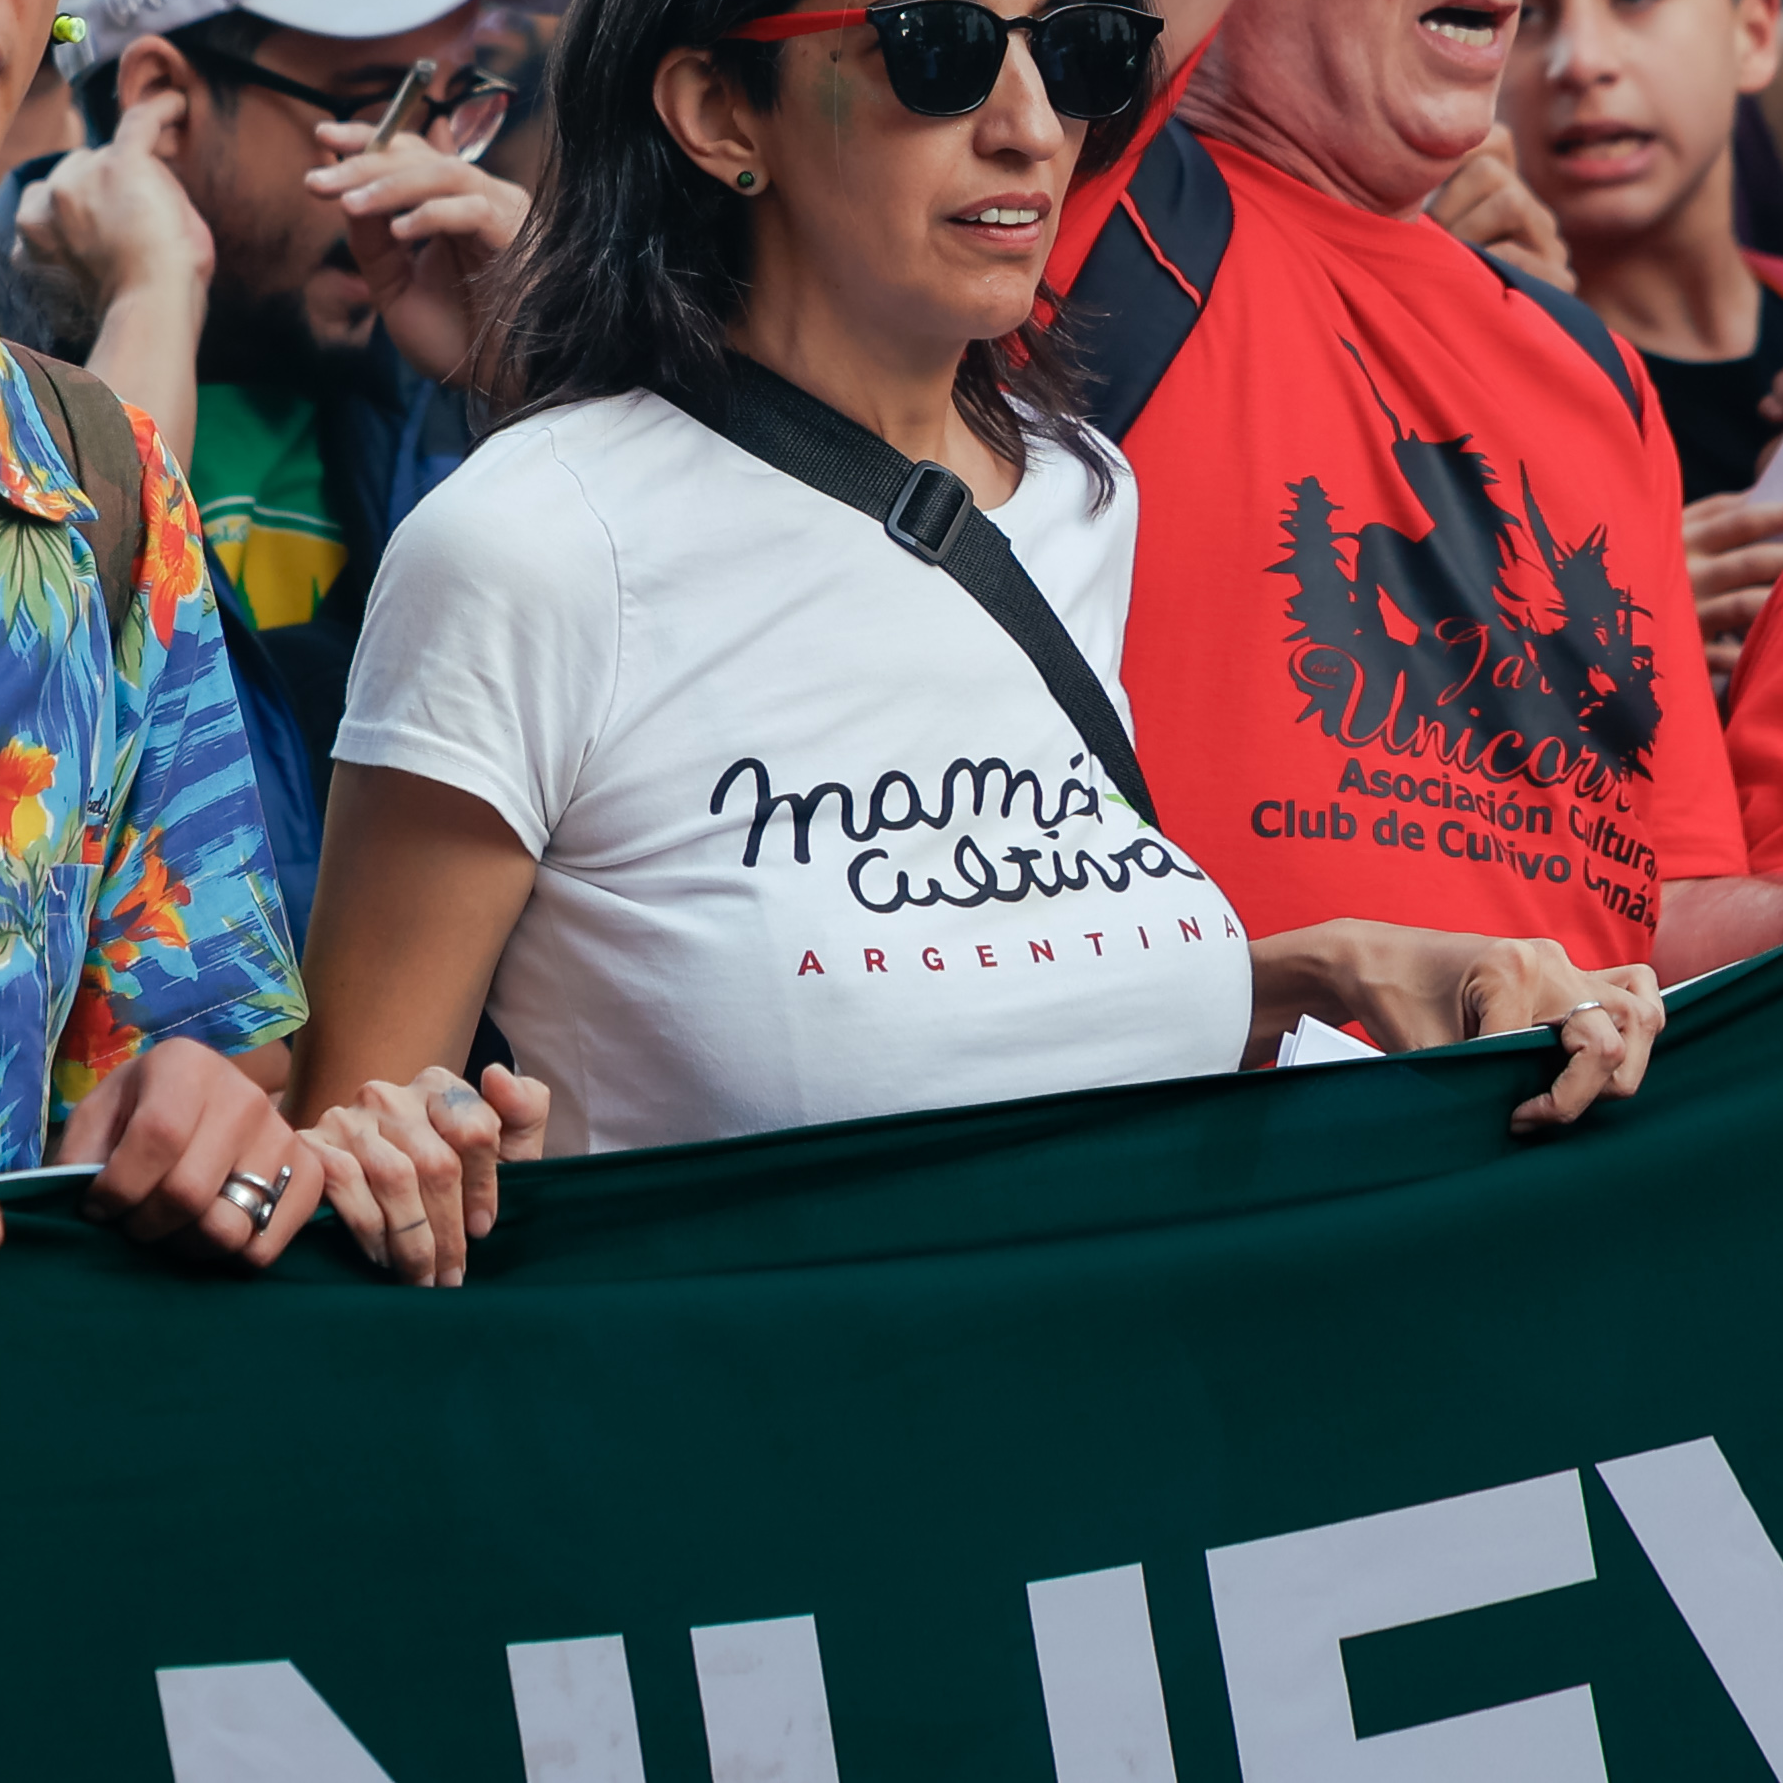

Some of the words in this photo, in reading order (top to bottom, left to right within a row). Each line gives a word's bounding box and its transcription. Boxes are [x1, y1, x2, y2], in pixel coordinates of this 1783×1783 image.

[1251, 799, 1358, 842] Club
[1373, 809, 1426, 851] de
[1338, 758, 1553, 835] Asociación
[1569, 804, 1658, 883] Cultura
[797, 913, 1239, 976] ARGENTINA
